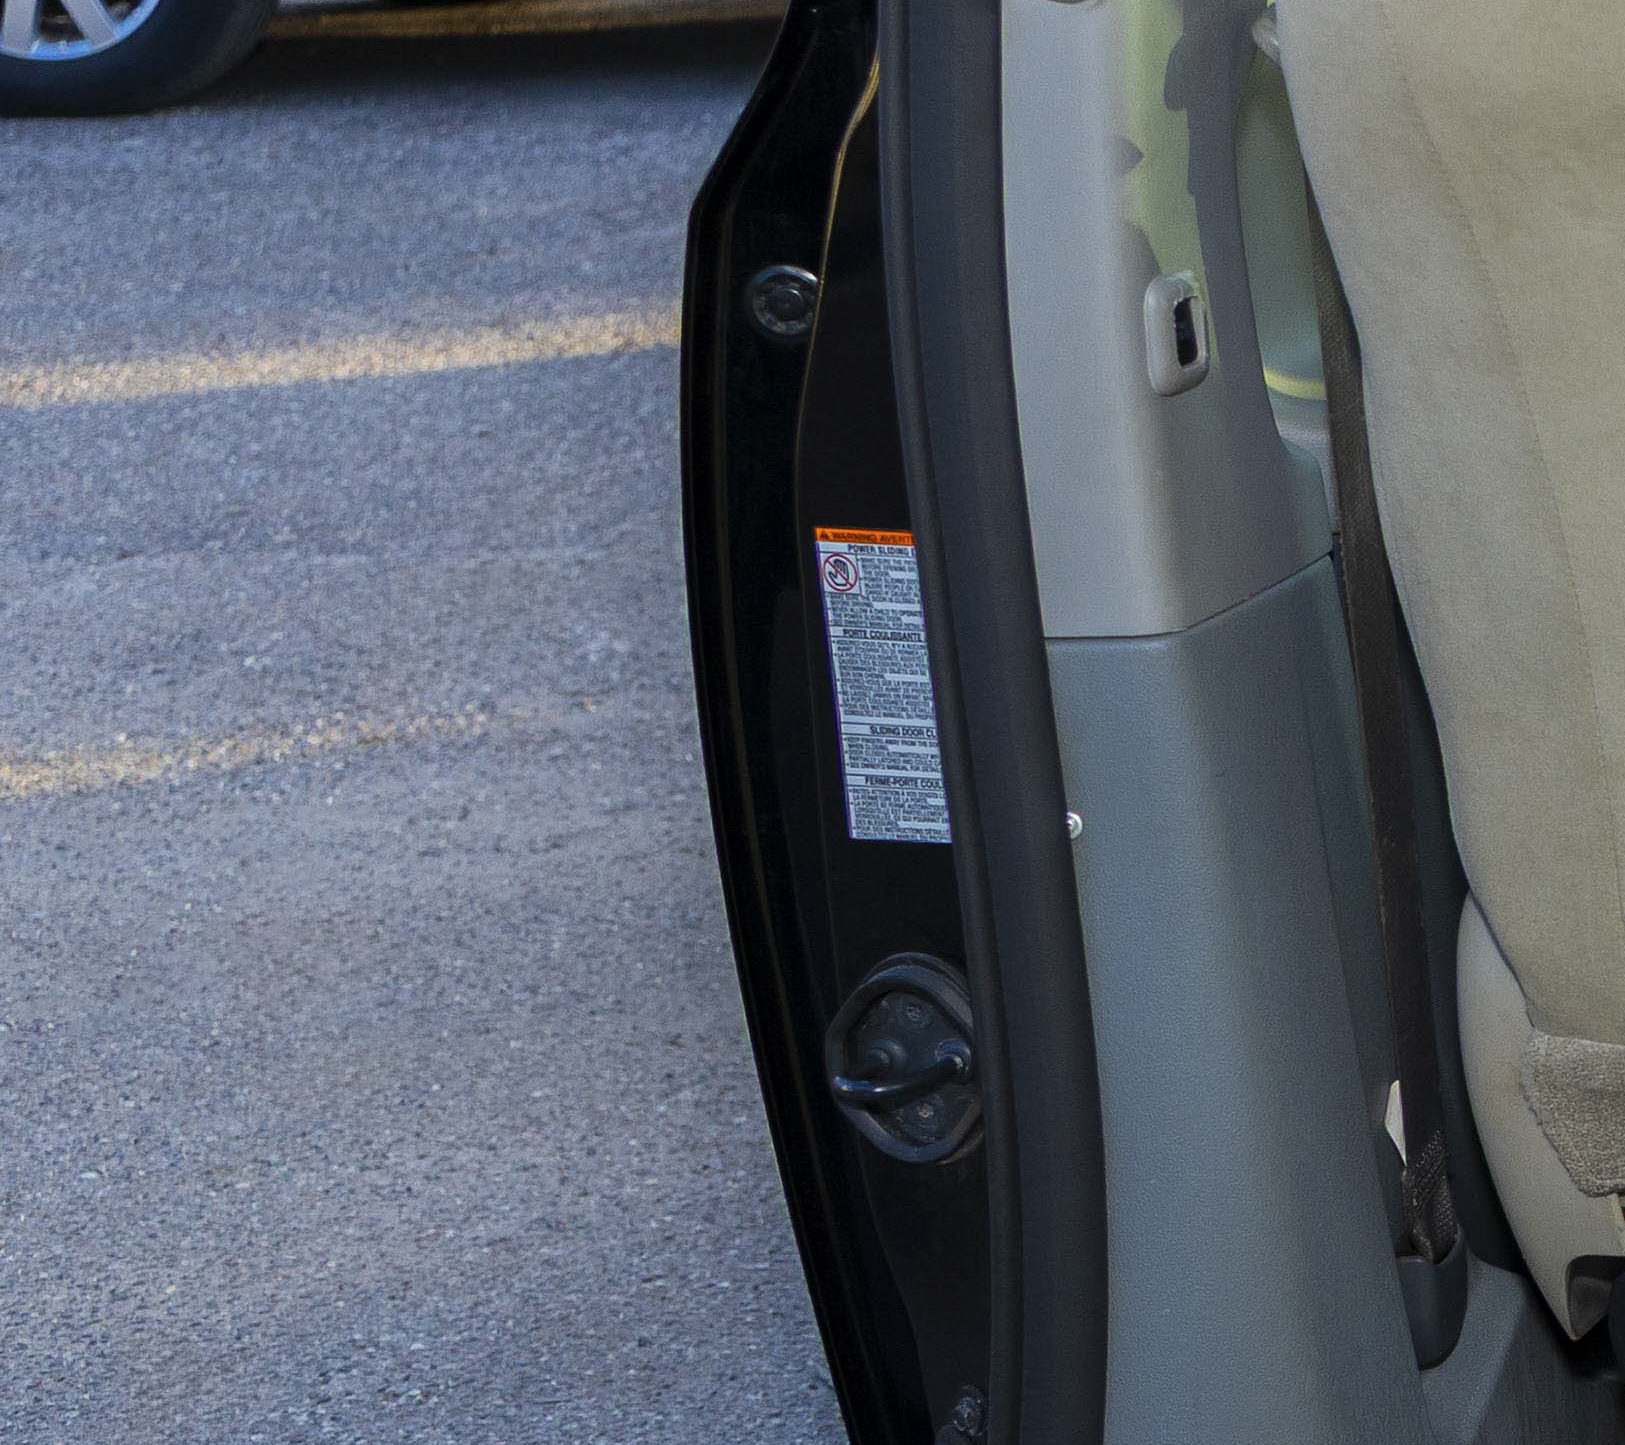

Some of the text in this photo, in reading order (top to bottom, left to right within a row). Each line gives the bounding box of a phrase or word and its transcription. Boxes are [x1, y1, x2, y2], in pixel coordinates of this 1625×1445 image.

[832, 531, 877, 542] WARNING
[848, 544, 875, 555] POWER
[842, 628, 868, 639] PORTE
[870, 725, 901, 735] SLIDING
[902, 727, 925, 737] DOOR
[865, 776, 919, 788] FERME-PORTE
